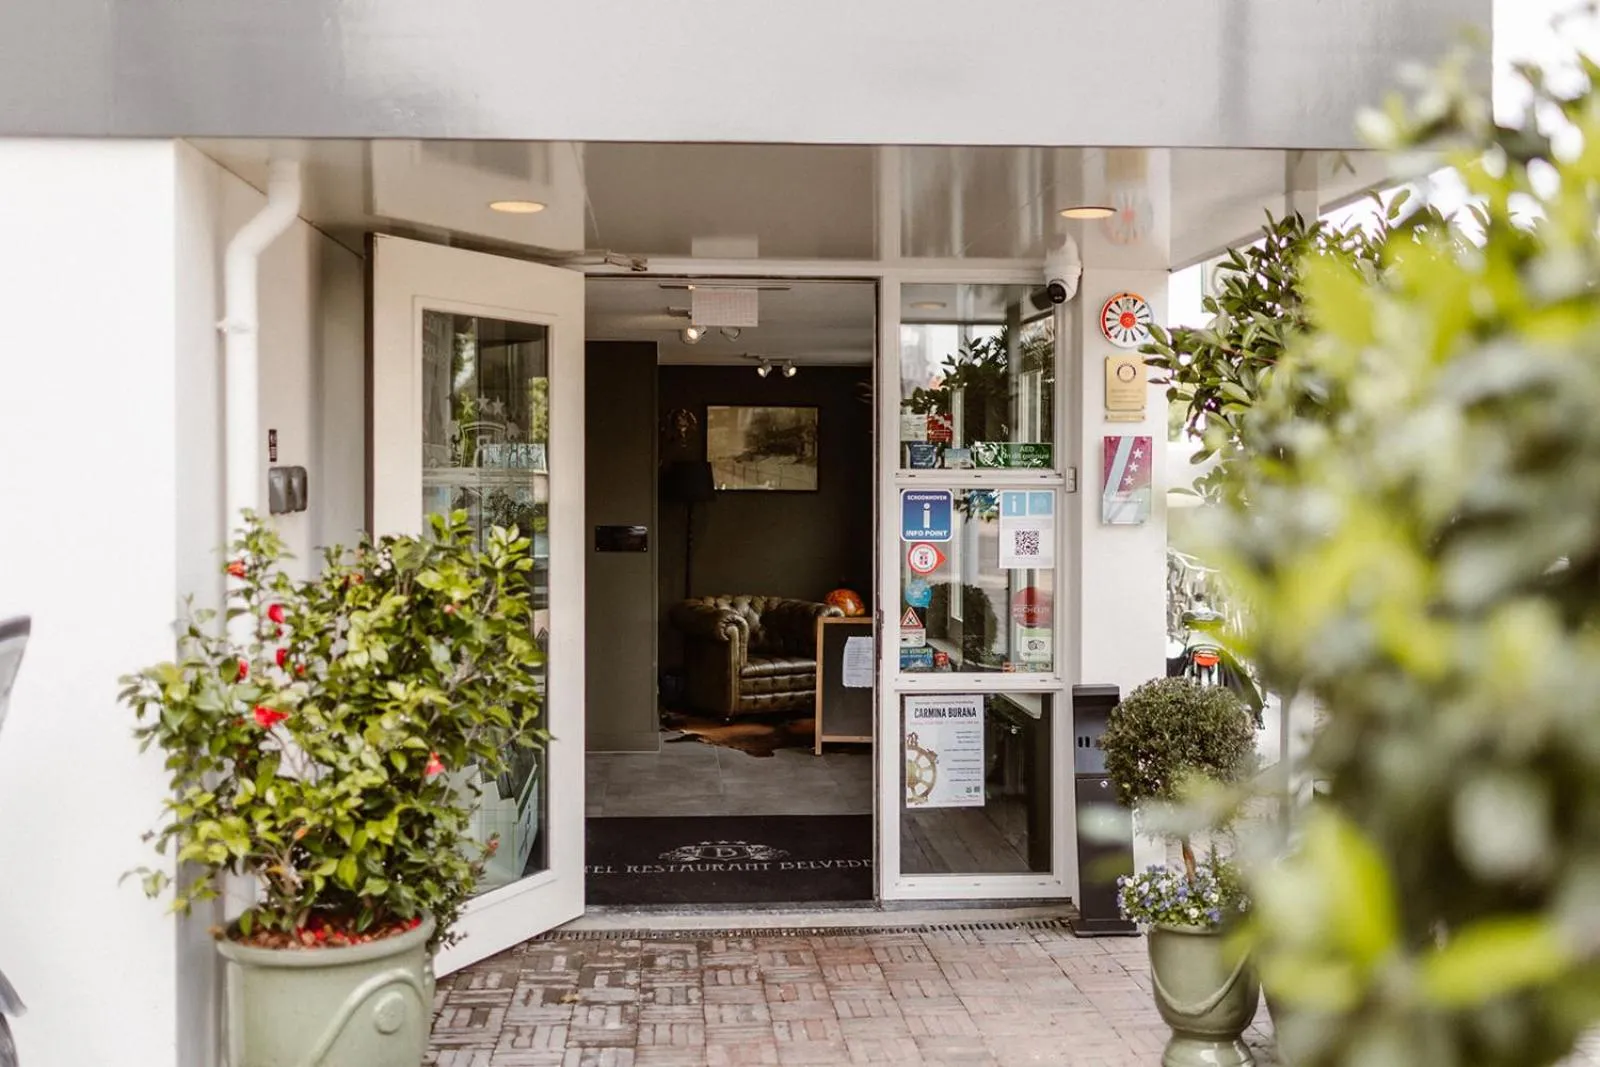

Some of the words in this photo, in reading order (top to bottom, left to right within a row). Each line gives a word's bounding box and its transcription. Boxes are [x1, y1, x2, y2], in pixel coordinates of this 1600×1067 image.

[925, 529, 948, 537] POINT
[914, 707, 946, 719] CARMINA
[948, 707, 977, 718] BURANA
[626, 862, 772, 874] RESTAURANT
